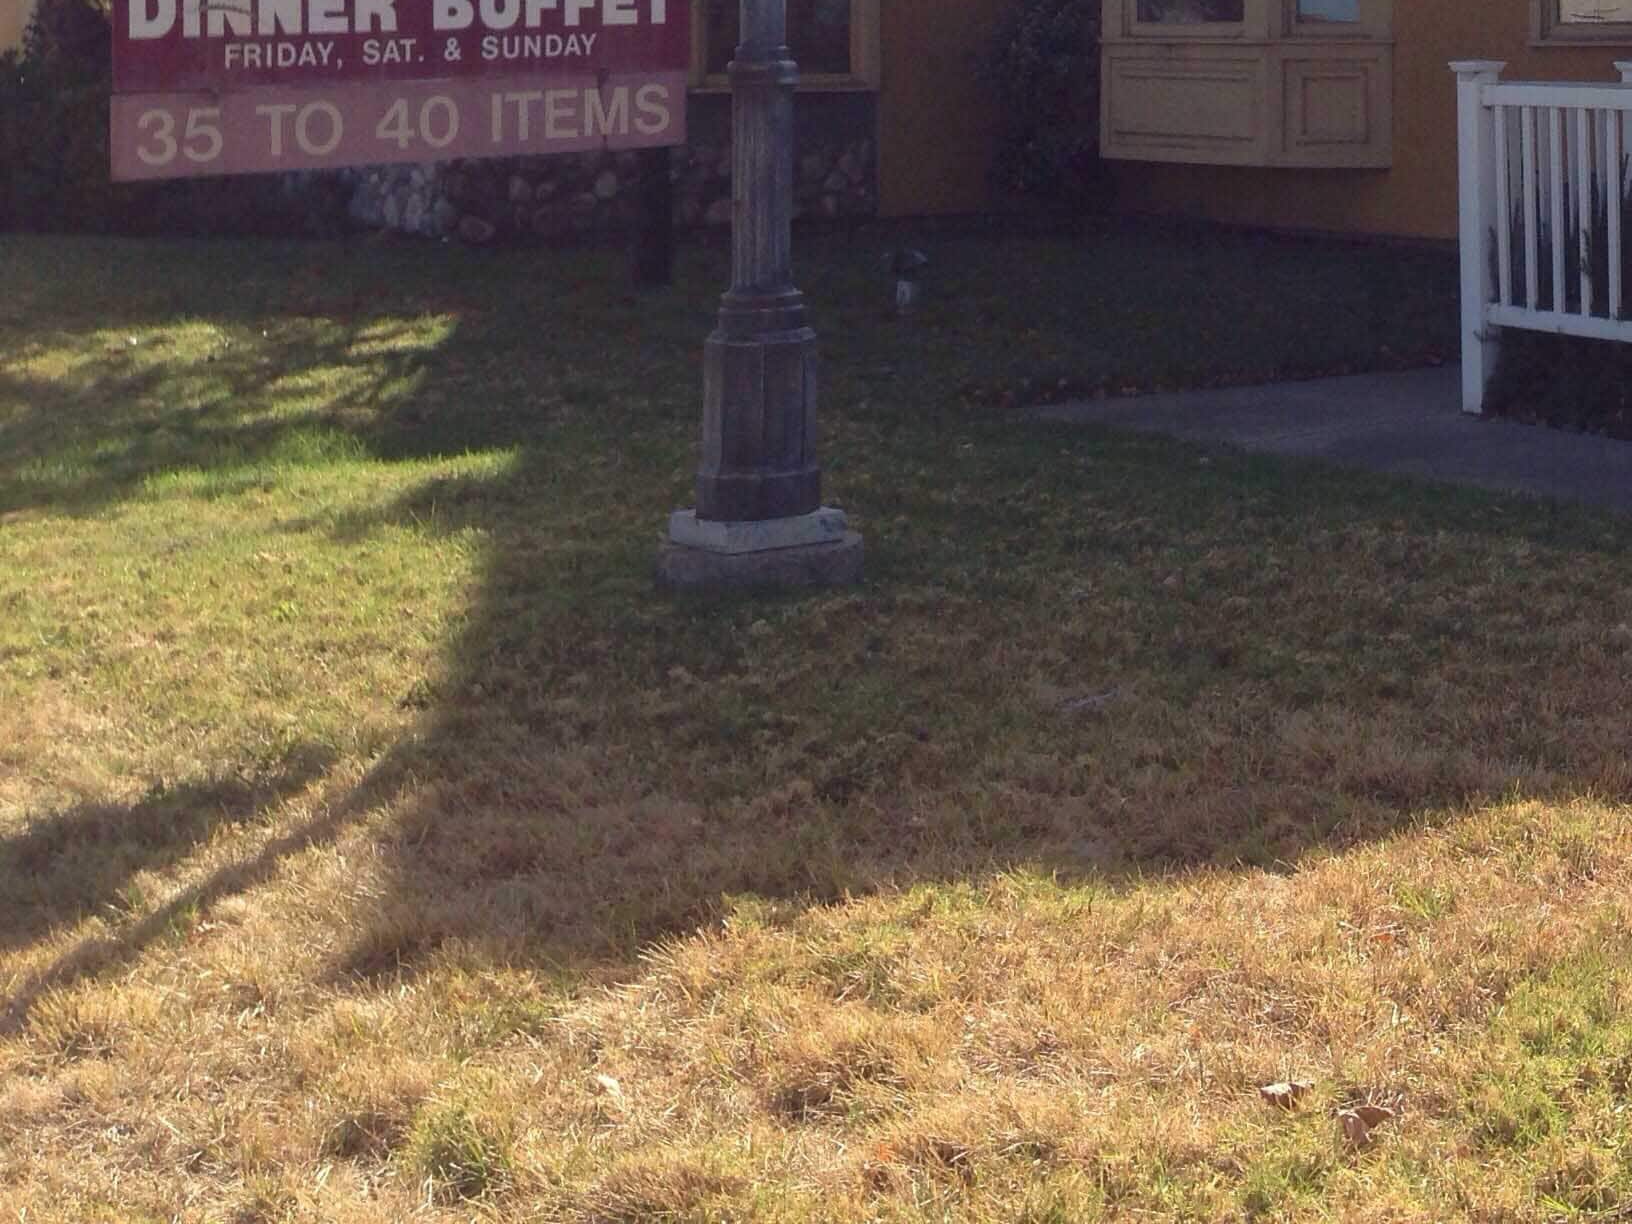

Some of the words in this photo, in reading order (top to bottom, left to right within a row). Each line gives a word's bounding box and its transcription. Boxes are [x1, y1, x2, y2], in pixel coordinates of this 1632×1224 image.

[224, 43, 343, 69] FRIDAY,
[362, 40, 424, 64] SAT.
[444, 39, 461, 61] &
[481, 33, 596, 60] SUNDAY
[136, 107, 223, 165] 35
[256, 102, 344, 154] TO
[376, 95, 460, 148] 40
[491, 84, 670, 142] ITEMS
